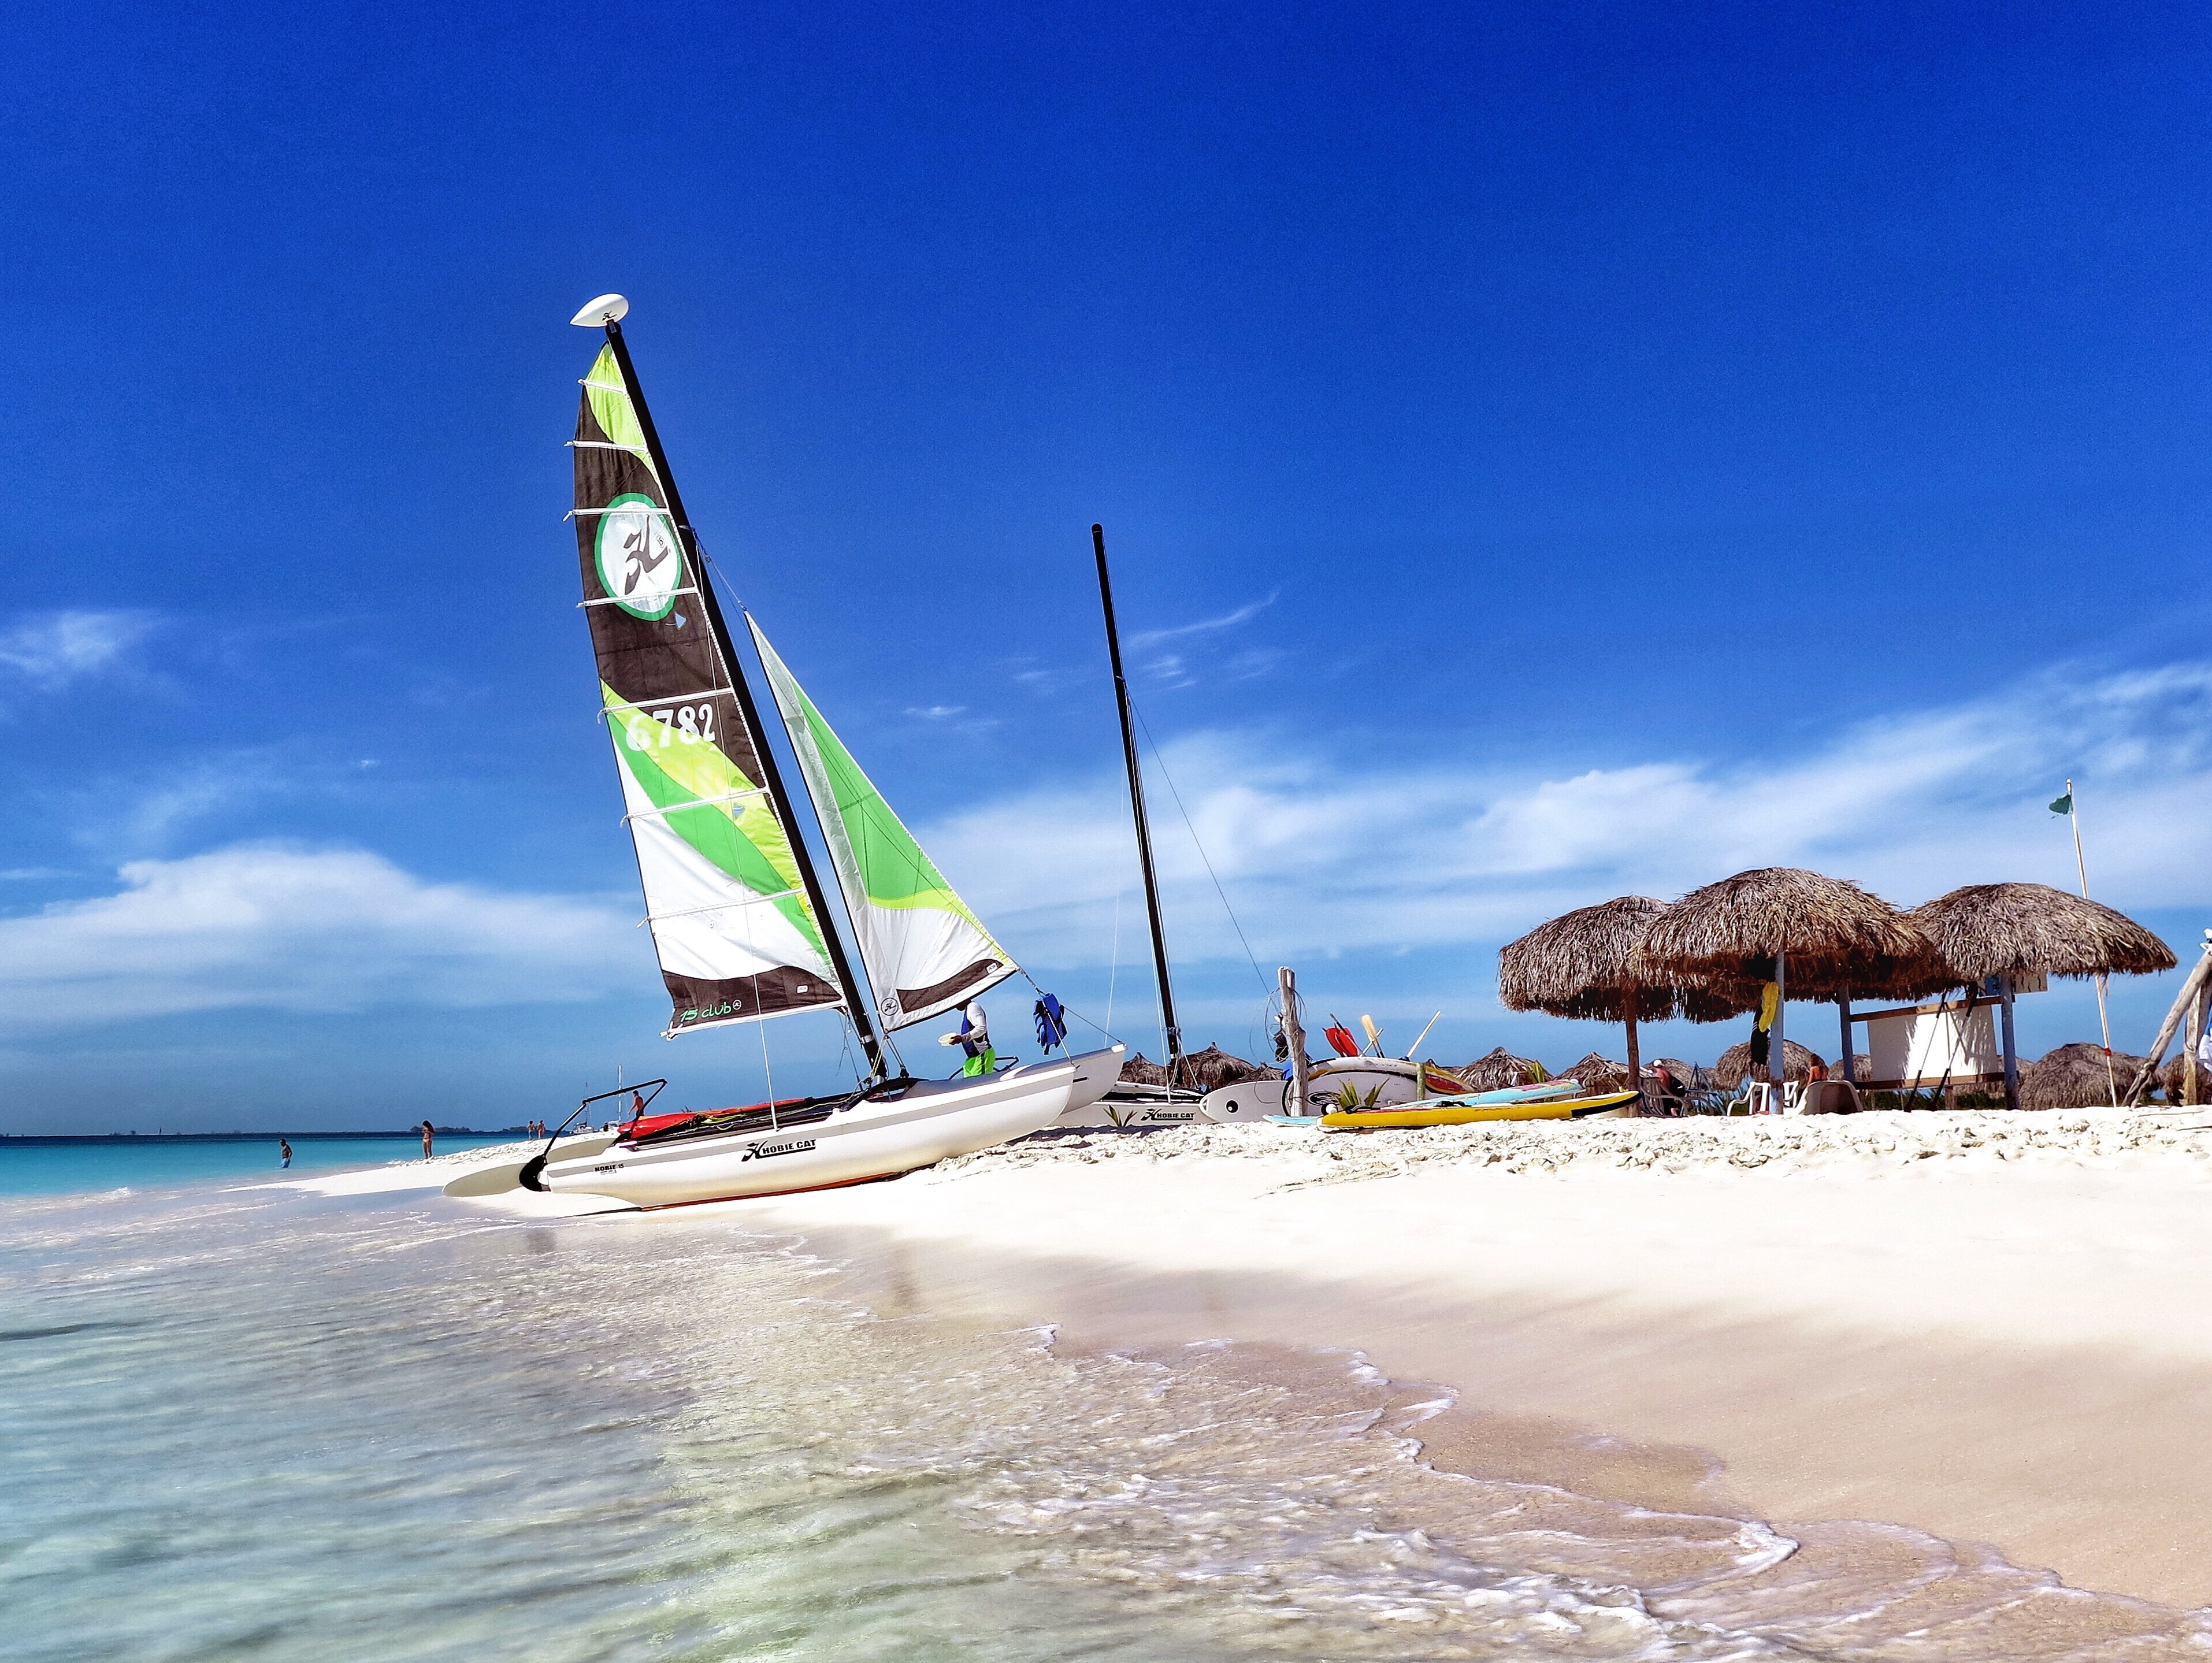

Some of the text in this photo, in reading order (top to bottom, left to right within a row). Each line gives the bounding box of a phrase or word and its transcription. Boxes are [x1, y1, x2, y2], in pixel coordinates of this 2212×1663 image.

[626, 703, 716, 751] 6782
[680, 1001, 732, 1022] 15 club
[762, 1139, 816, 1155] HOBIE CAT
